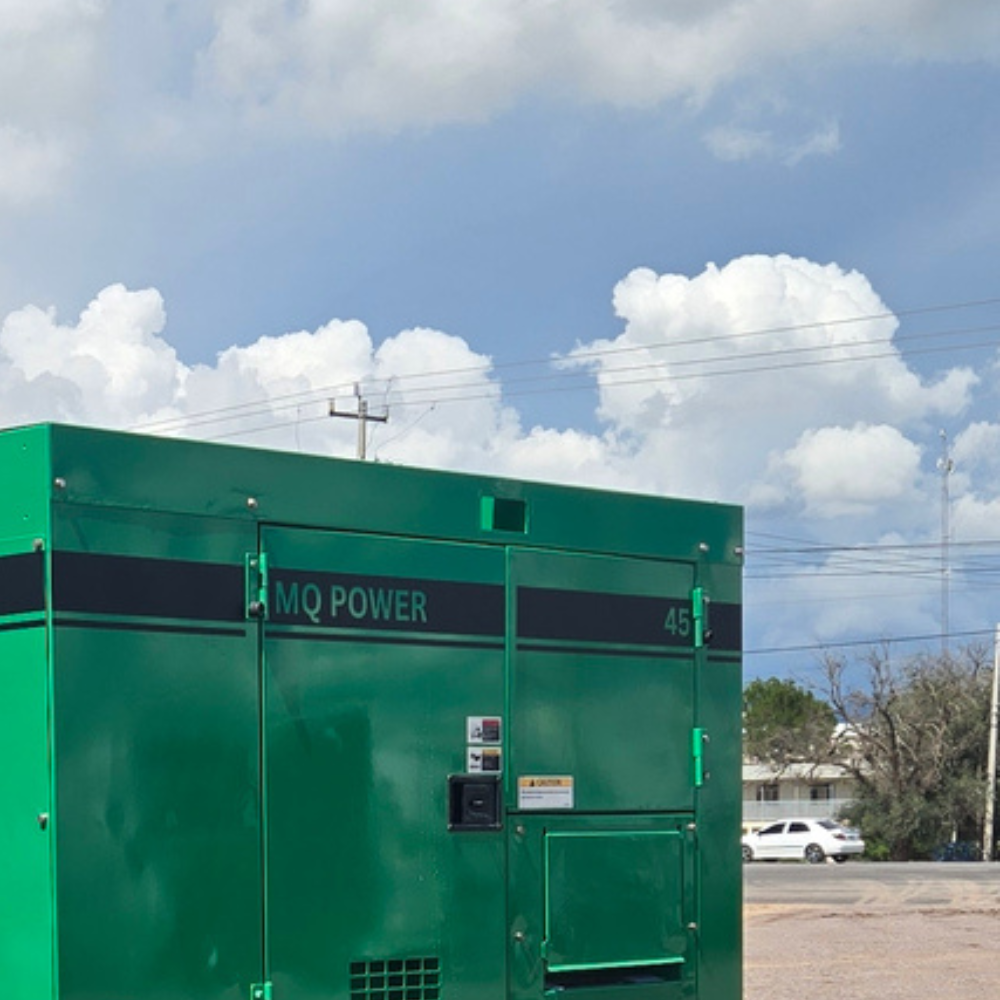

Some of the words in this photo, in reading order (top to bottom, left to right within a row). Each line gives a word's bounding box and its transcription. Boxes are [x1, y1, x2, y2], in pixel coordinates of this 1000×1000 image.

[275, 580, 322, 623] MQ
[330, 584, 428, 623] POWER
[664, 607, 690, 636] 45
